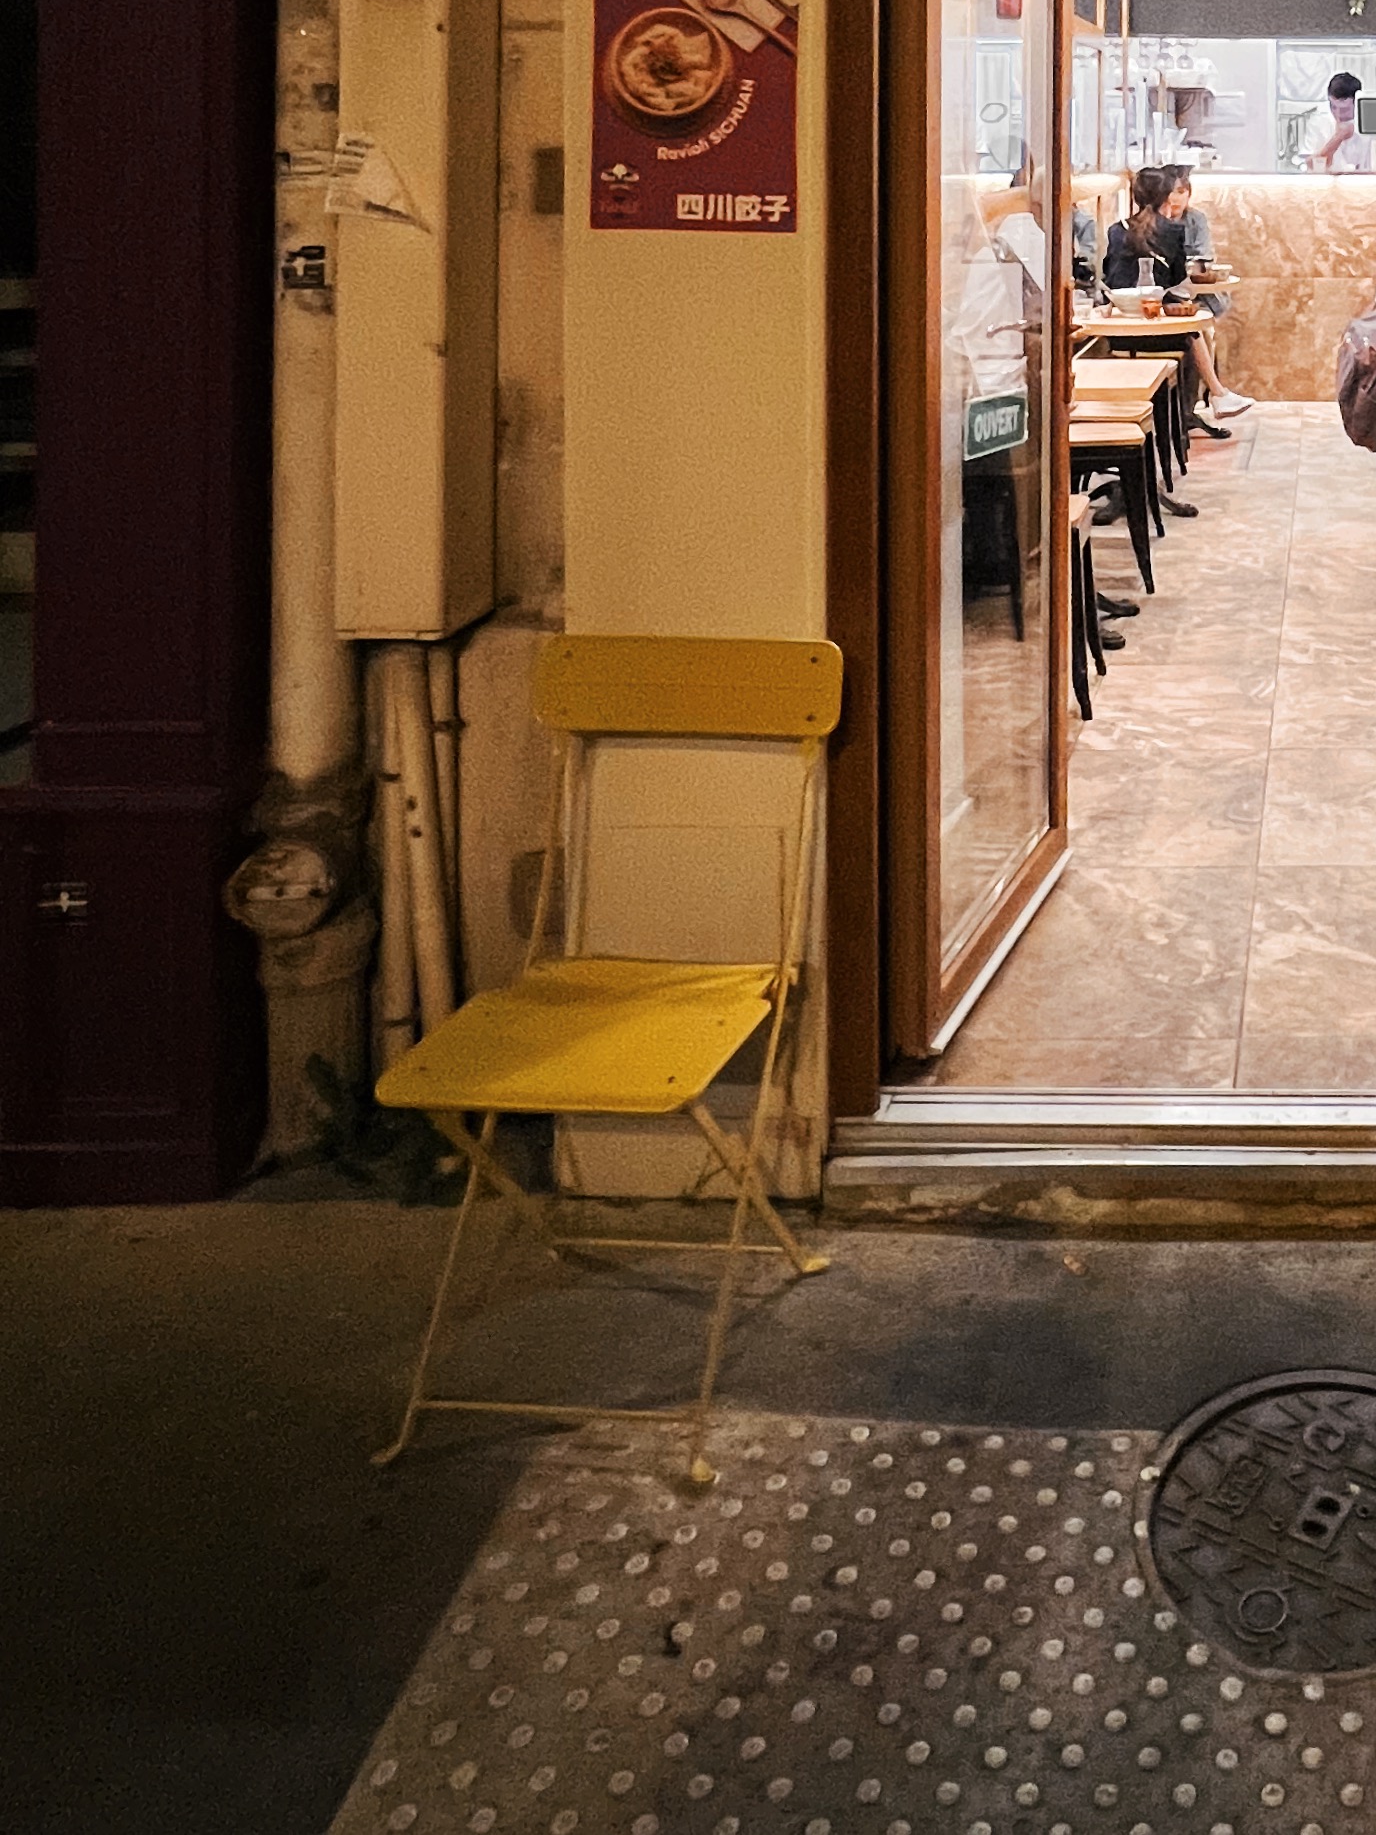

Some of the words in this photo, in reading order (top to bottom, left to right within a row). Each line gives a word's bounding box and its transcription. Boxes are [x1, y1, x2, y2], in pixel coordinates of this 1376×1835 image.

[656, 138, 711, 161] Ravioli
[707, 78, 757, 146] SICHUAN
[973, 404, 1021, 443] OUVERT
